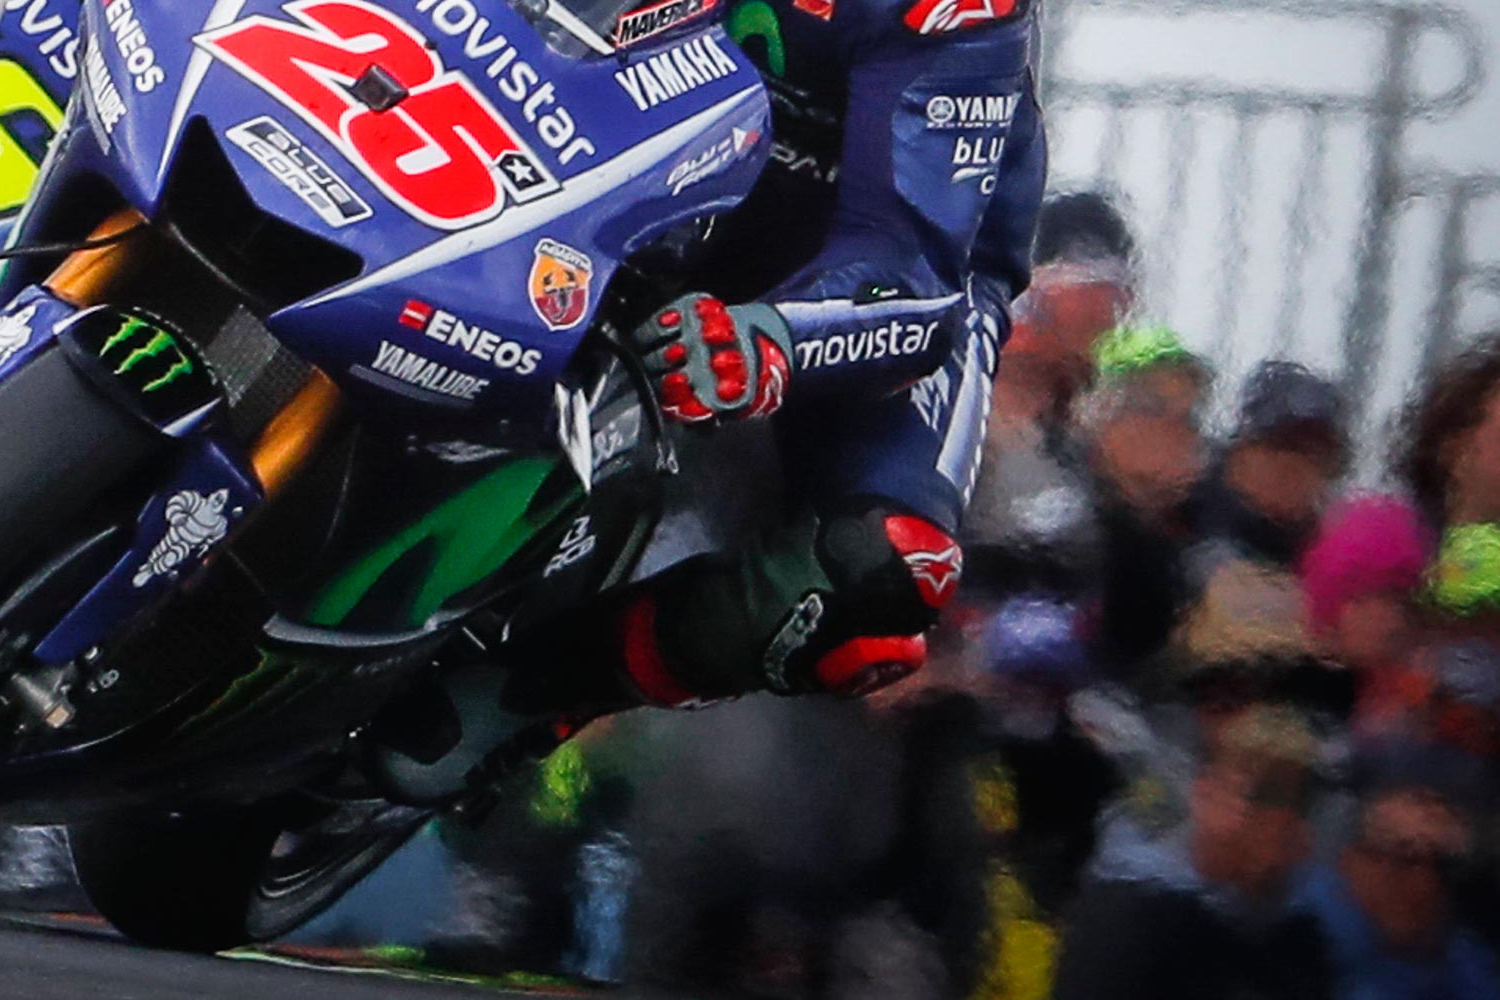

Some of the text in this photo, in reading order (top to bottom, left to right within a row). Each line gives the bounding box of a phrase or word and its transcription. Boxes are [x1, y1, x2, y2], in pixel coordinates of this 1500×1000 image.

[614, 33, 739, 112] YAMAHA
[370, 339, 491, 401] YAMALUBE
[424, 309, 543, 376] ENEOS
[796, 320, 940, 371] movistar
